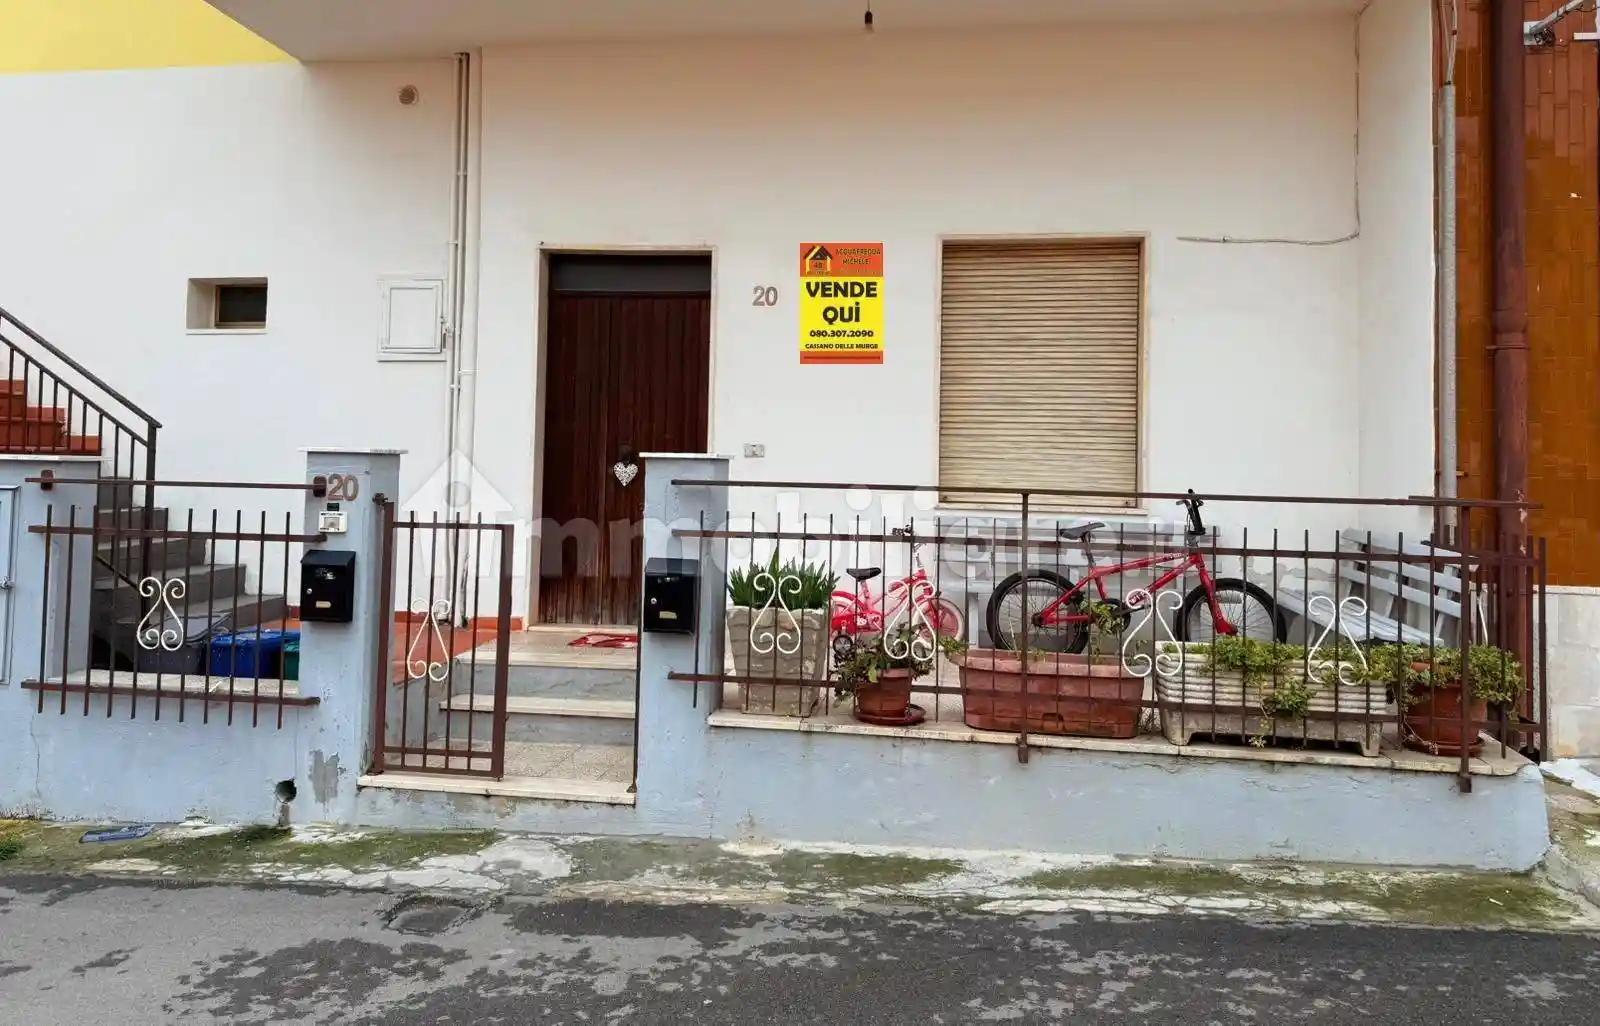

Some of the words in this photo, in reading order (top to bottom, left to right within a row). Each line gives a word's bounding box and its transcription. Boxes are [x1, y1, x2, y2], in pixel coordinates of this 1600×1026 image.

[752, 285, 778, 307] 20
[805, 281, 878, 298] VENDE
[328, 473, 359, 501] 20
